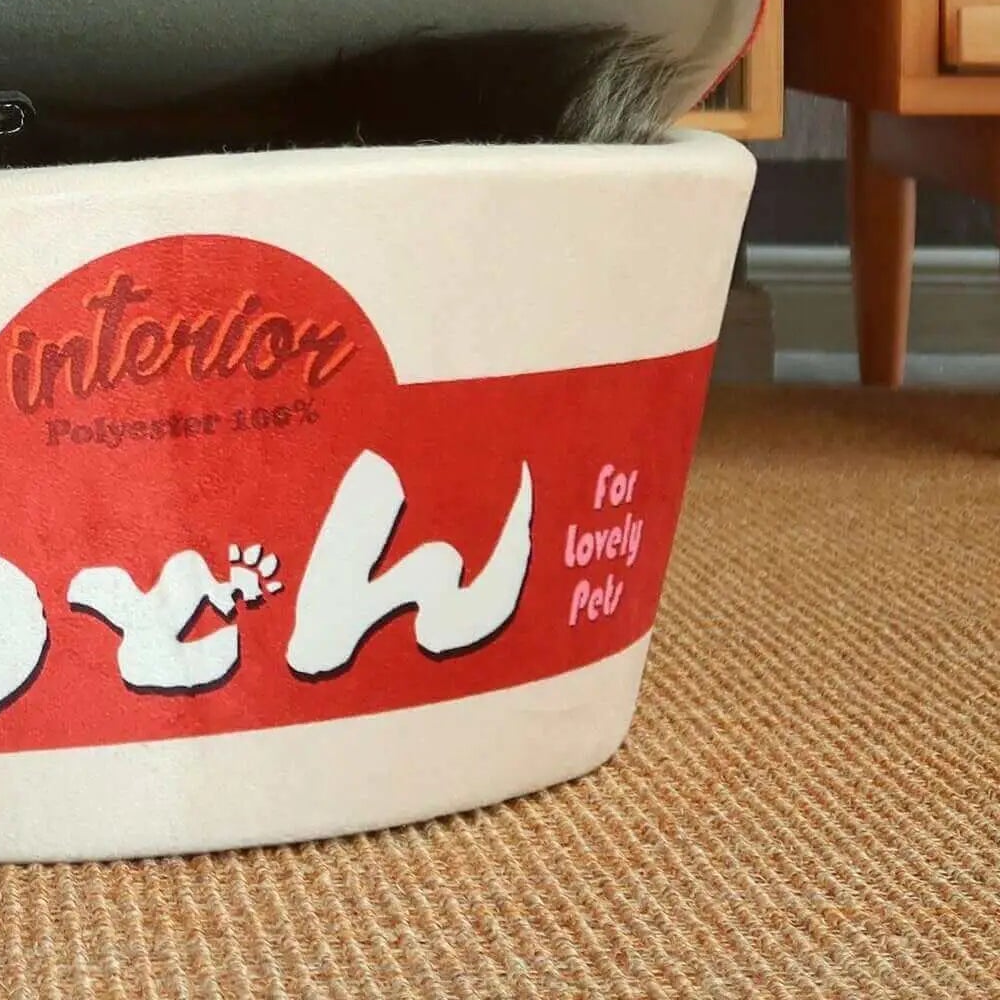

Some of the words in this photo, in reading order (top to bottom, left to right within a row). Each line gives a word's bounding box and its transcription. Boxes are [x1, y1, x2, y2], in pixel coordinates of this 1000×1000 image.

[7, 270, 358, 415] interior
[45, 410, 219, 449] Polyester
[231, 398, 320, 432] 100%
